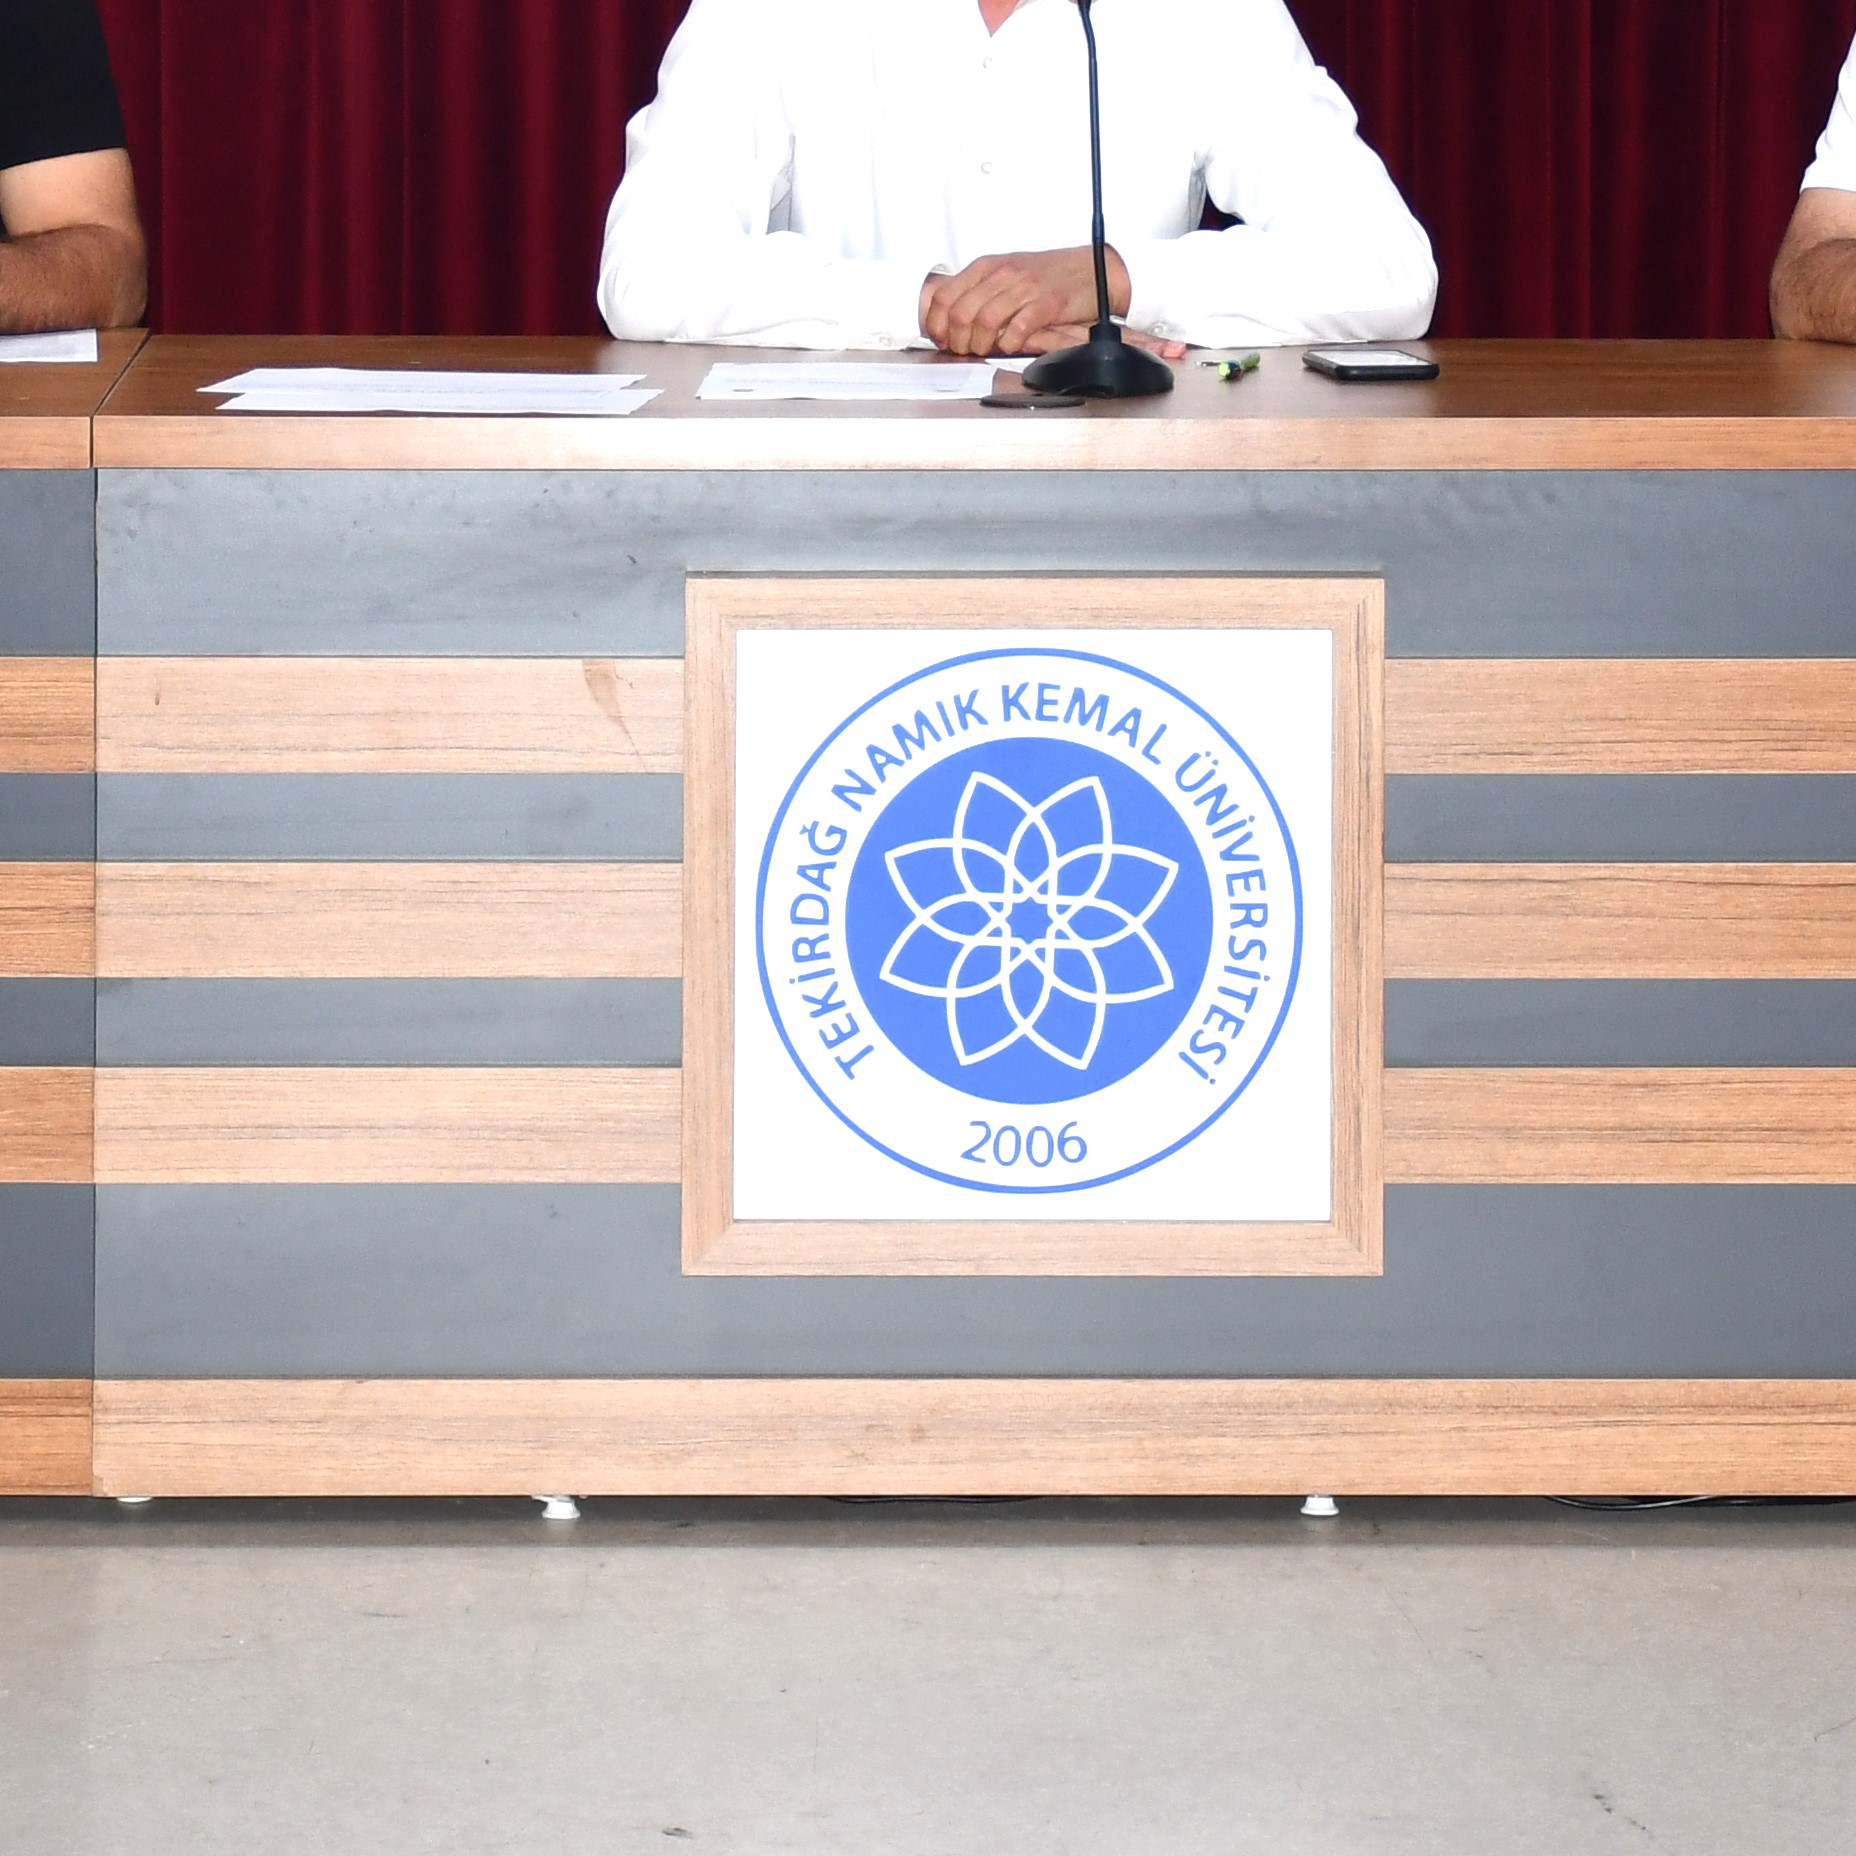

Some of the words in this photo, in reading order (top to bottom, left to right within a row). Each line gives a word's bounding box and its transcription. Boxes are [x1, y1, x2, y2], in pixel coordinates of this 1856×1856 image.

[831, 689, 989, 813] NAMIK
[1001, 681, 1168, 766] KEMAL
[789, 820, 875, 1080] TEKİRDAĞ
[1175, 750, 1270, 1085] ÜNİVERSİTESİ
[960, 1120, 1088, 1168] 2006
